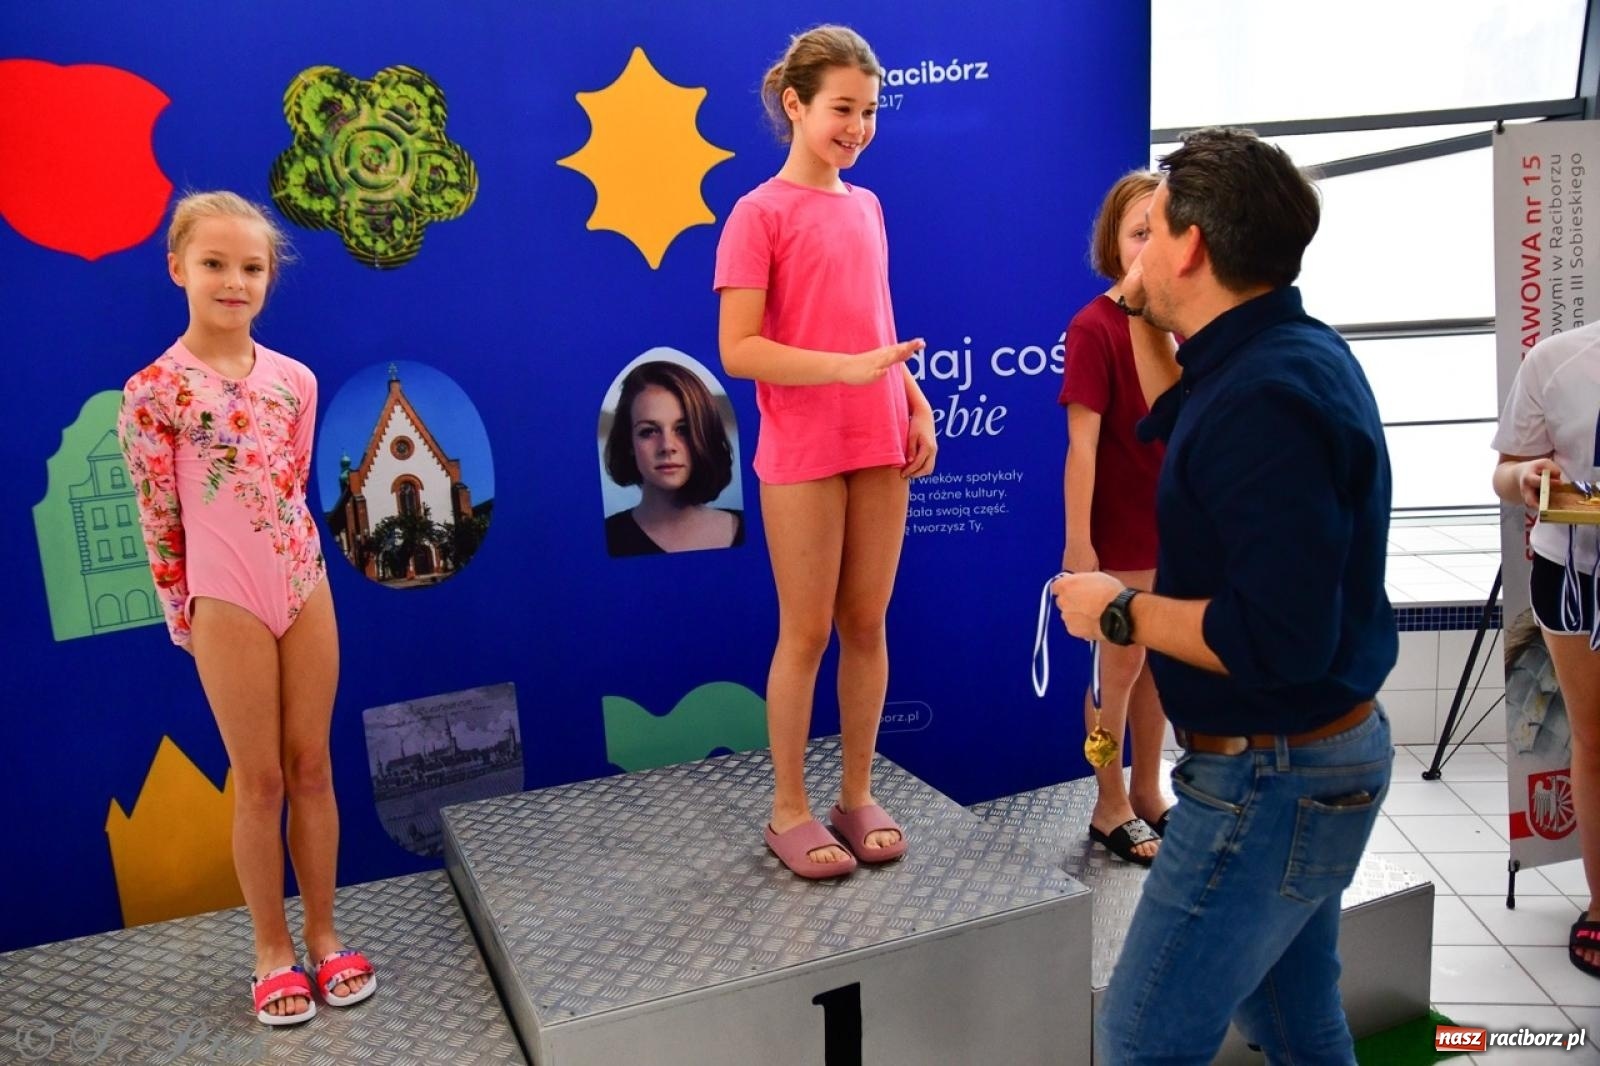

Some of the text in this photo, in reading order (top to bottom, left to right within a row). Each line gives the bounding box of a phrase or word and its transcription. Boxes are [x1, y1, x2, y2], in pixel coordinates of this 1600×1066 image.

[1549, 154, 1563, 249] Raciborzu
[1568, 153, 1585, 268] Sobieskiego
[1521, 155, 1542, 361] AWOWA nr 15
[1552, 255, 1563, 271] w
[1571, 275, 1584, 290] III
[990, 331, 1066, 377] coś
[919, 472, 962, 485] wieków
[966, 469, 1024, 485] spotykały
[928, 489, 962, 500] różne
[965, 487, 1007, 500] kultury.
[935, 505, 971, 518] swoją
[973, 503, 1009, 516] część.
[913, 523, 965, 535] tworzysz
[812, 981, 863, 1066] 1
